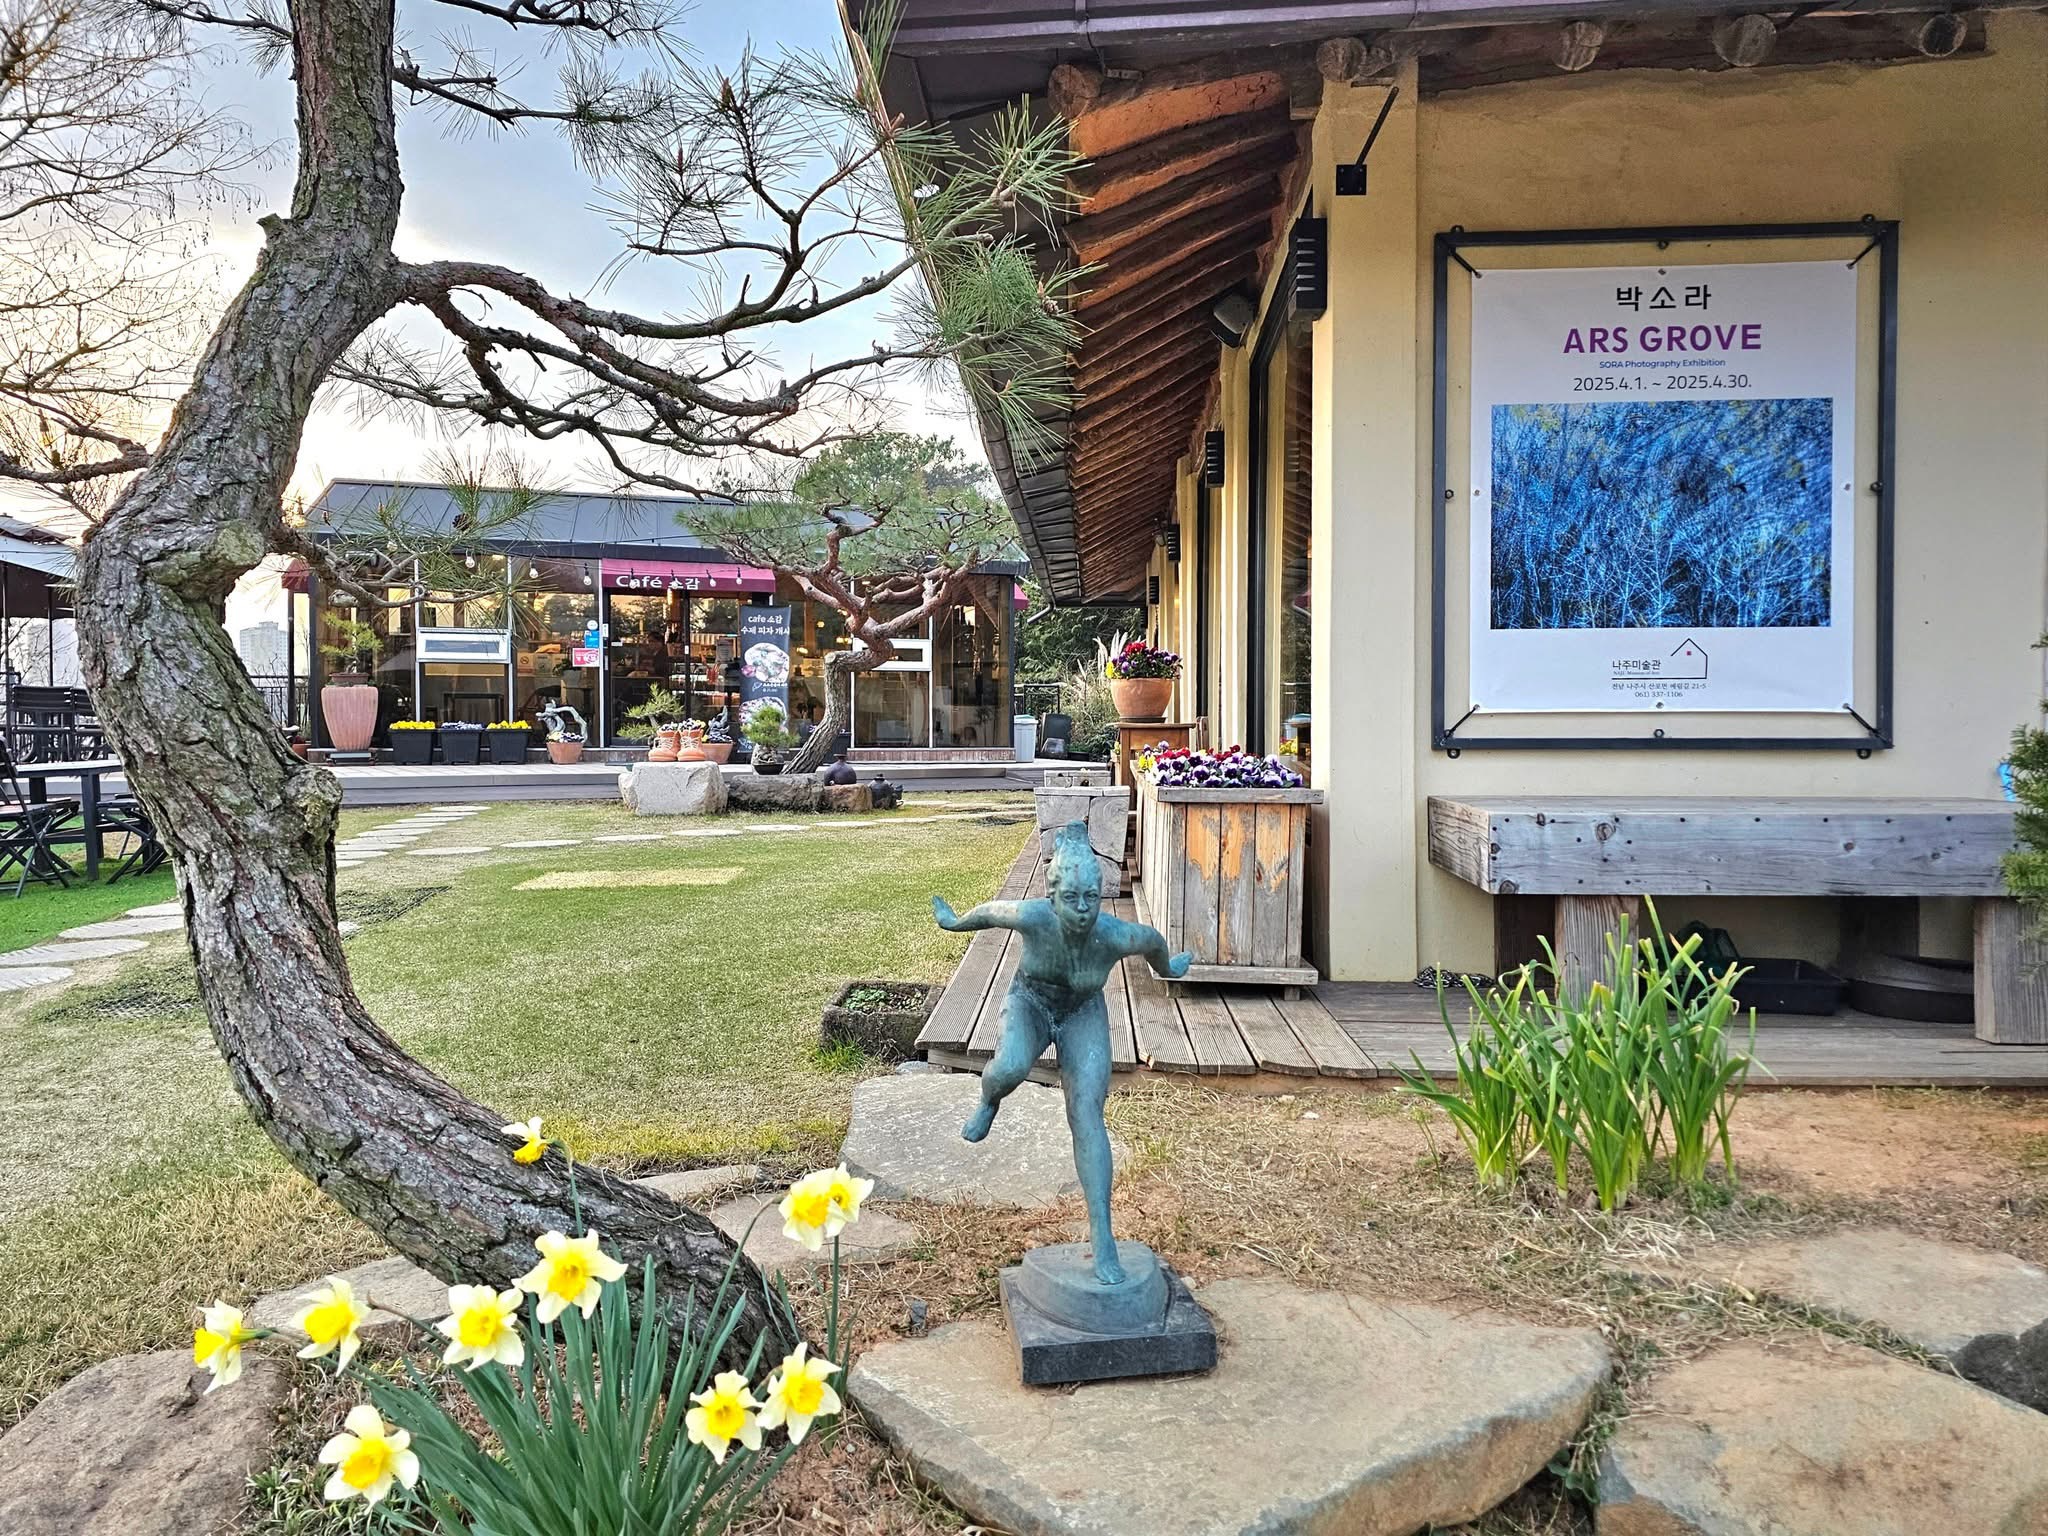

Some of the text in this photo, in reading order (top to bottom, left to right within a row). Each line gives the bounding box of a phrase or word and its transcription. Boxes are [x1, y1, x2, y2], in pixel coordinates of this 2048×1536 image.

[1616, 284, 1712, 312] 박소라
[1562, 323, 1762, 353] ARS GROVE
[1599, 357, 1726, 369] SORA Photography Exhibition
[1573, 376, 1647, 391] 2025.4.1.
[1667, 374, 1752, 390] 2025.4.30.
[616, 575, 700, 590] Café 소감
[748, 614, 783, 624] cafe 소감
[741, 625, 756, 635] 수제
[758, 625, 774, 635] 피자
[1612, 659, 1661, 670] 나주미술관
[1627, 682, 1646, 690] 나주시
